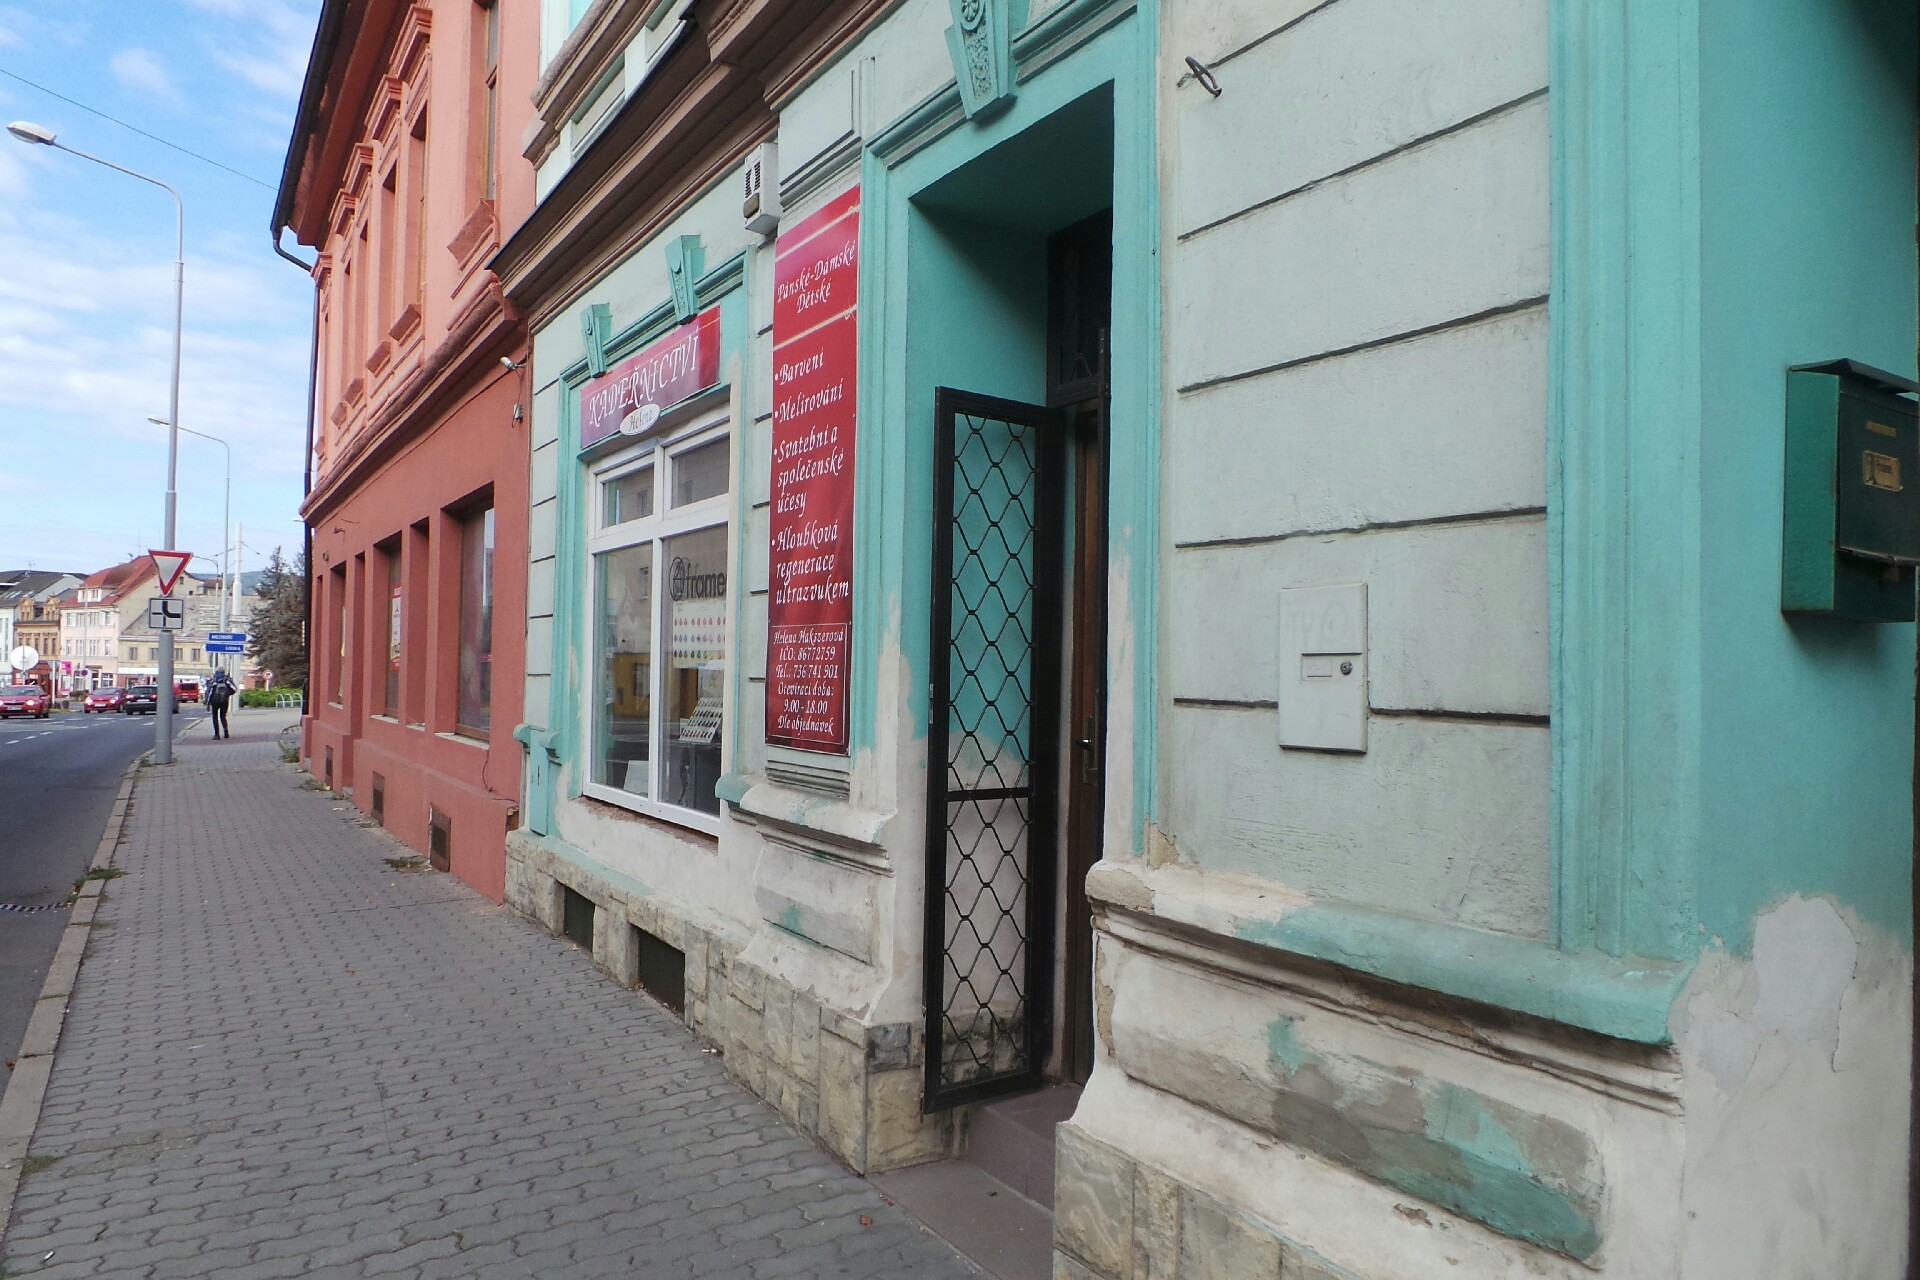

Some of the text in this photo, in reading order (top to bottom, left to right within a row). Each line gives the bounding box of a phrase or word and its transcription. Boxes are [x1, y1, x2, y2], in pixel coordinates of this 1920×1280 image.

[777, 240, 856, 303] Pánské-Dámské
[797, 278, 832, 313] Dětské
[589, 326, 699, 428] KADEŘNICTVÍ
[780, 347, 824, 385] Barvení
[777, 424, 838, 463] Svatební a
[777, 445, 844, 493] společenské
[777, 492, 806, 518] účesy
[776, 519, 838, 551] Hloubková
[685, 563, 727, 600] frame
[776, 554, 835, 584] regenerace
[776, 574, 849, 605] ultrazvukem
[774, 629, 797, 644] Helena
[797, 646, 836, 660] 86772759
[793, 664, 806, 678] 736
[808, 664, 822, 678] 741
[823, 664, 838, 678] 901
[813, 680, 834, 696] doba:
[784, 698, 800, 713] 9.00
[806, 699, 828, 714] 18.00
[778, 714, 834, 736] Dle objednávek
